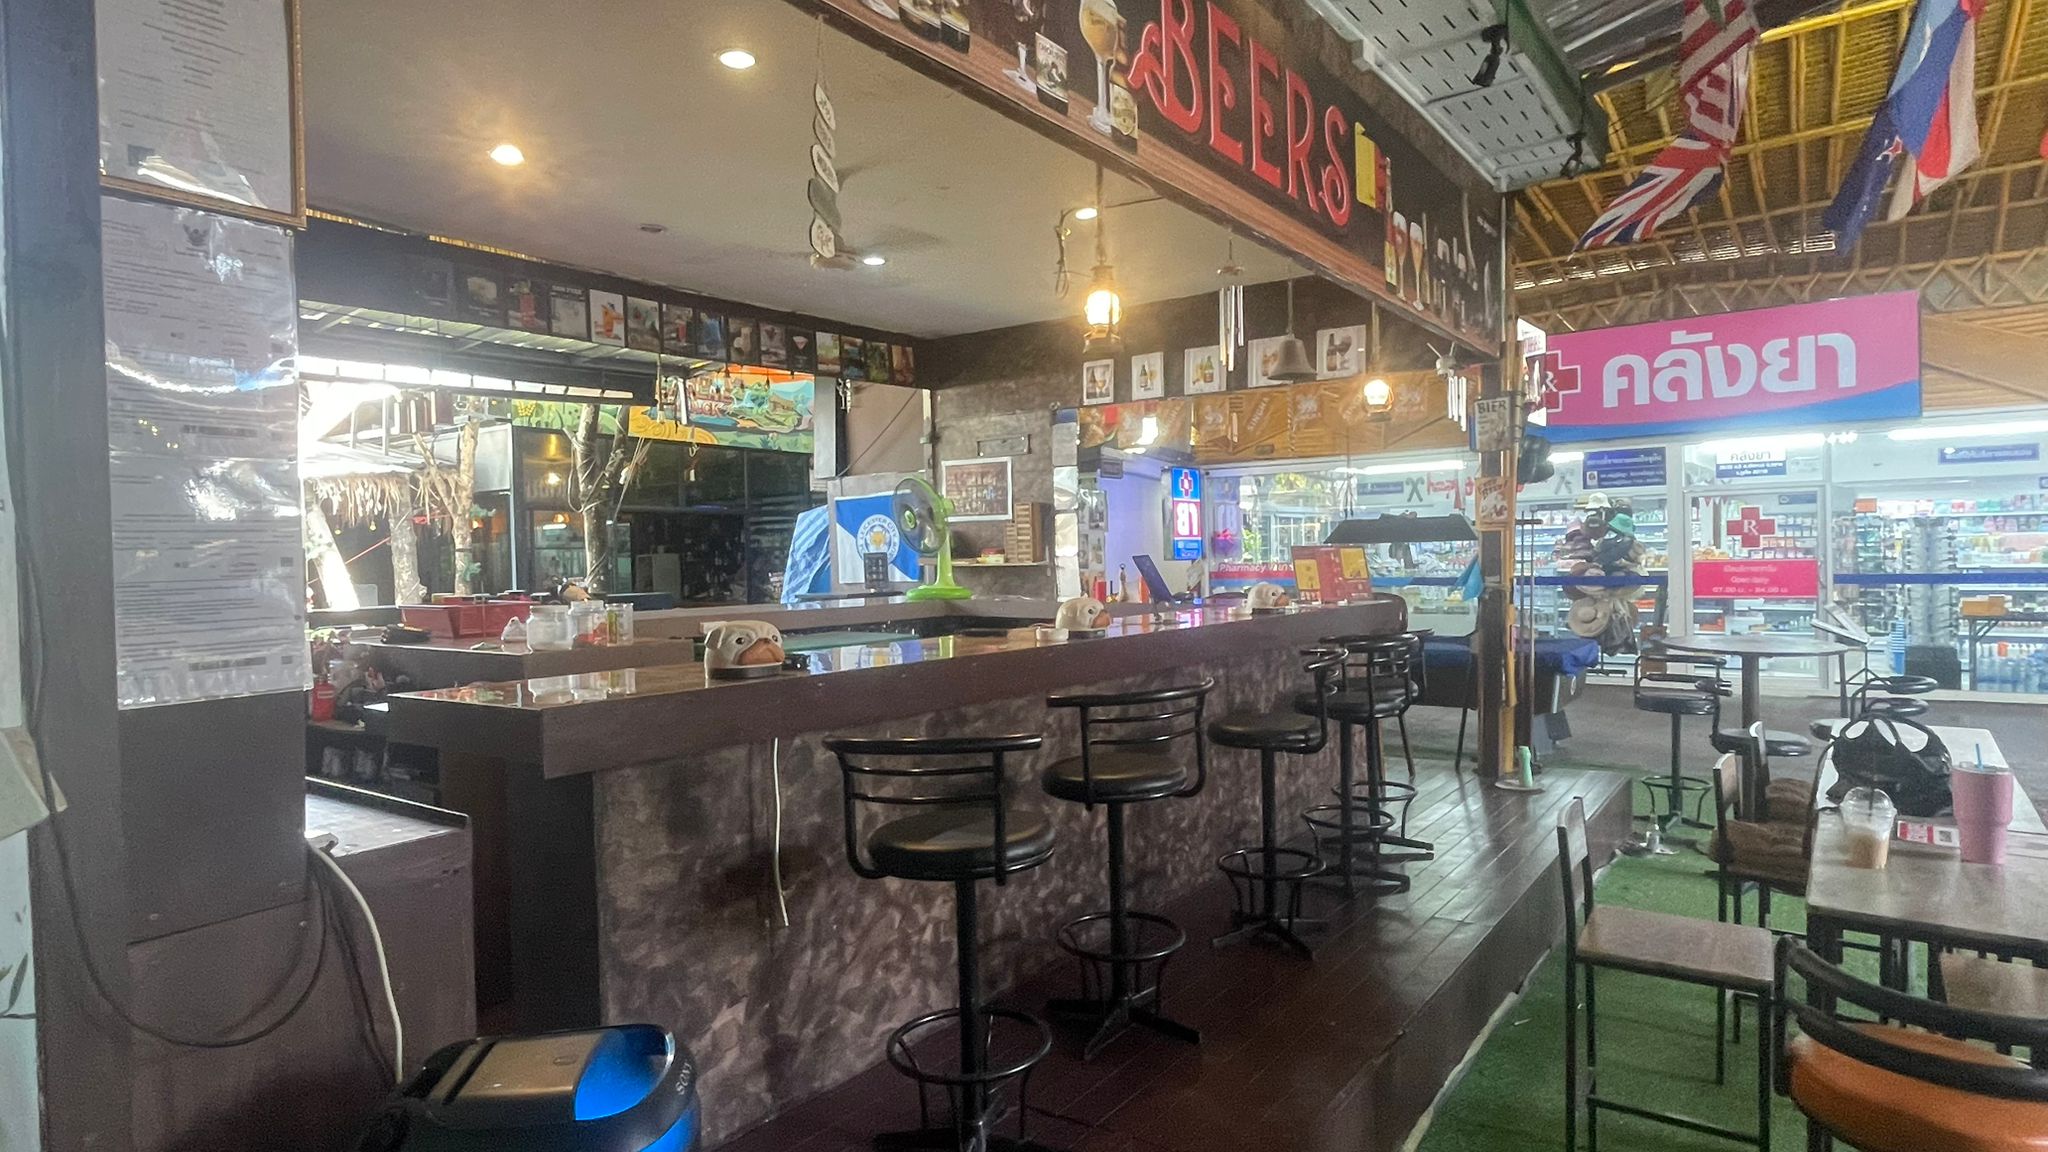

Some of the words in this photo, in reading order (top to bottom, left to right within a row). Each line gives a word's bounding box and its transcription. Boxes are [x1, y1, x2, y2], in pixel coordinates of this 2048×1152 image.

[1129, 0, 1351, 226] BEERS
[1602, 328, 1858, 408] คลังยา
[1477, 400, 1507, 413] BIER
[1219, 562, 1267, 573] Pharmacy
